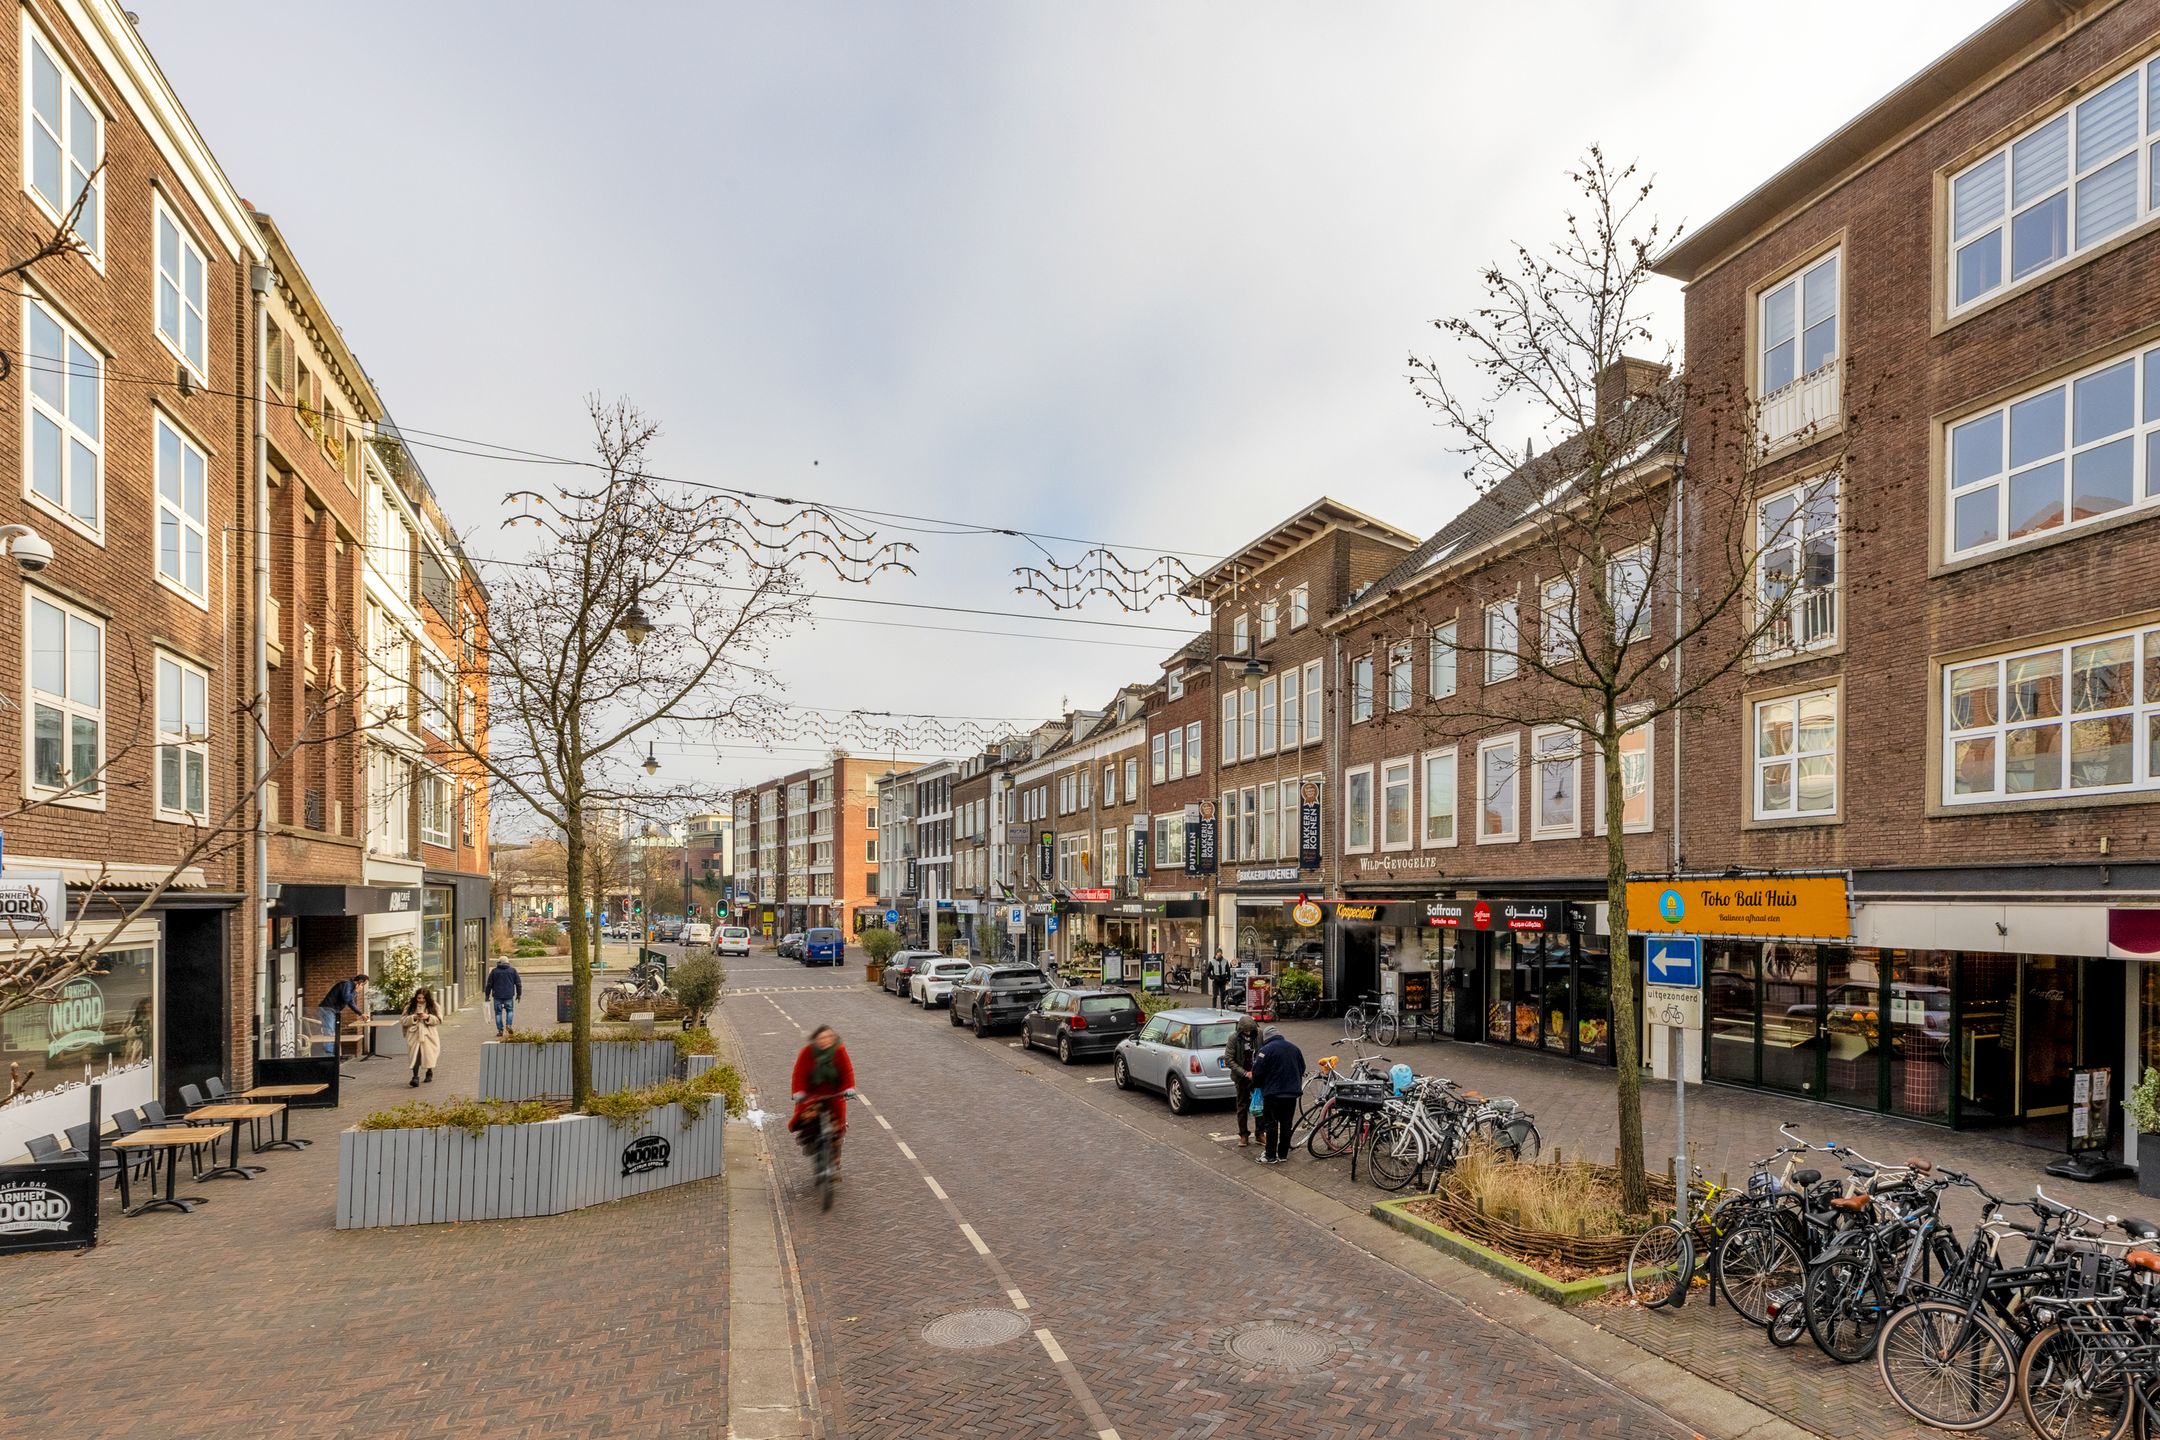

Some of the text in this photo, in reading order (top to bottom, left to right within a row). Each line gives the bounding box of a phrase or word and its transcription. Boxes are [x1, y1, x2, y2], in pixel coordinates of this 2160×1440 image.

[1701, 890, 1797, 906] Toko Bali Huis
[1426, 904, 1462, 916] Saffraan
[1648, 990, 1698, 1002] uitgezonderd
[52, 997, 101, 1035] NOORD
[625, 1144, 668, 1164] NOORD
